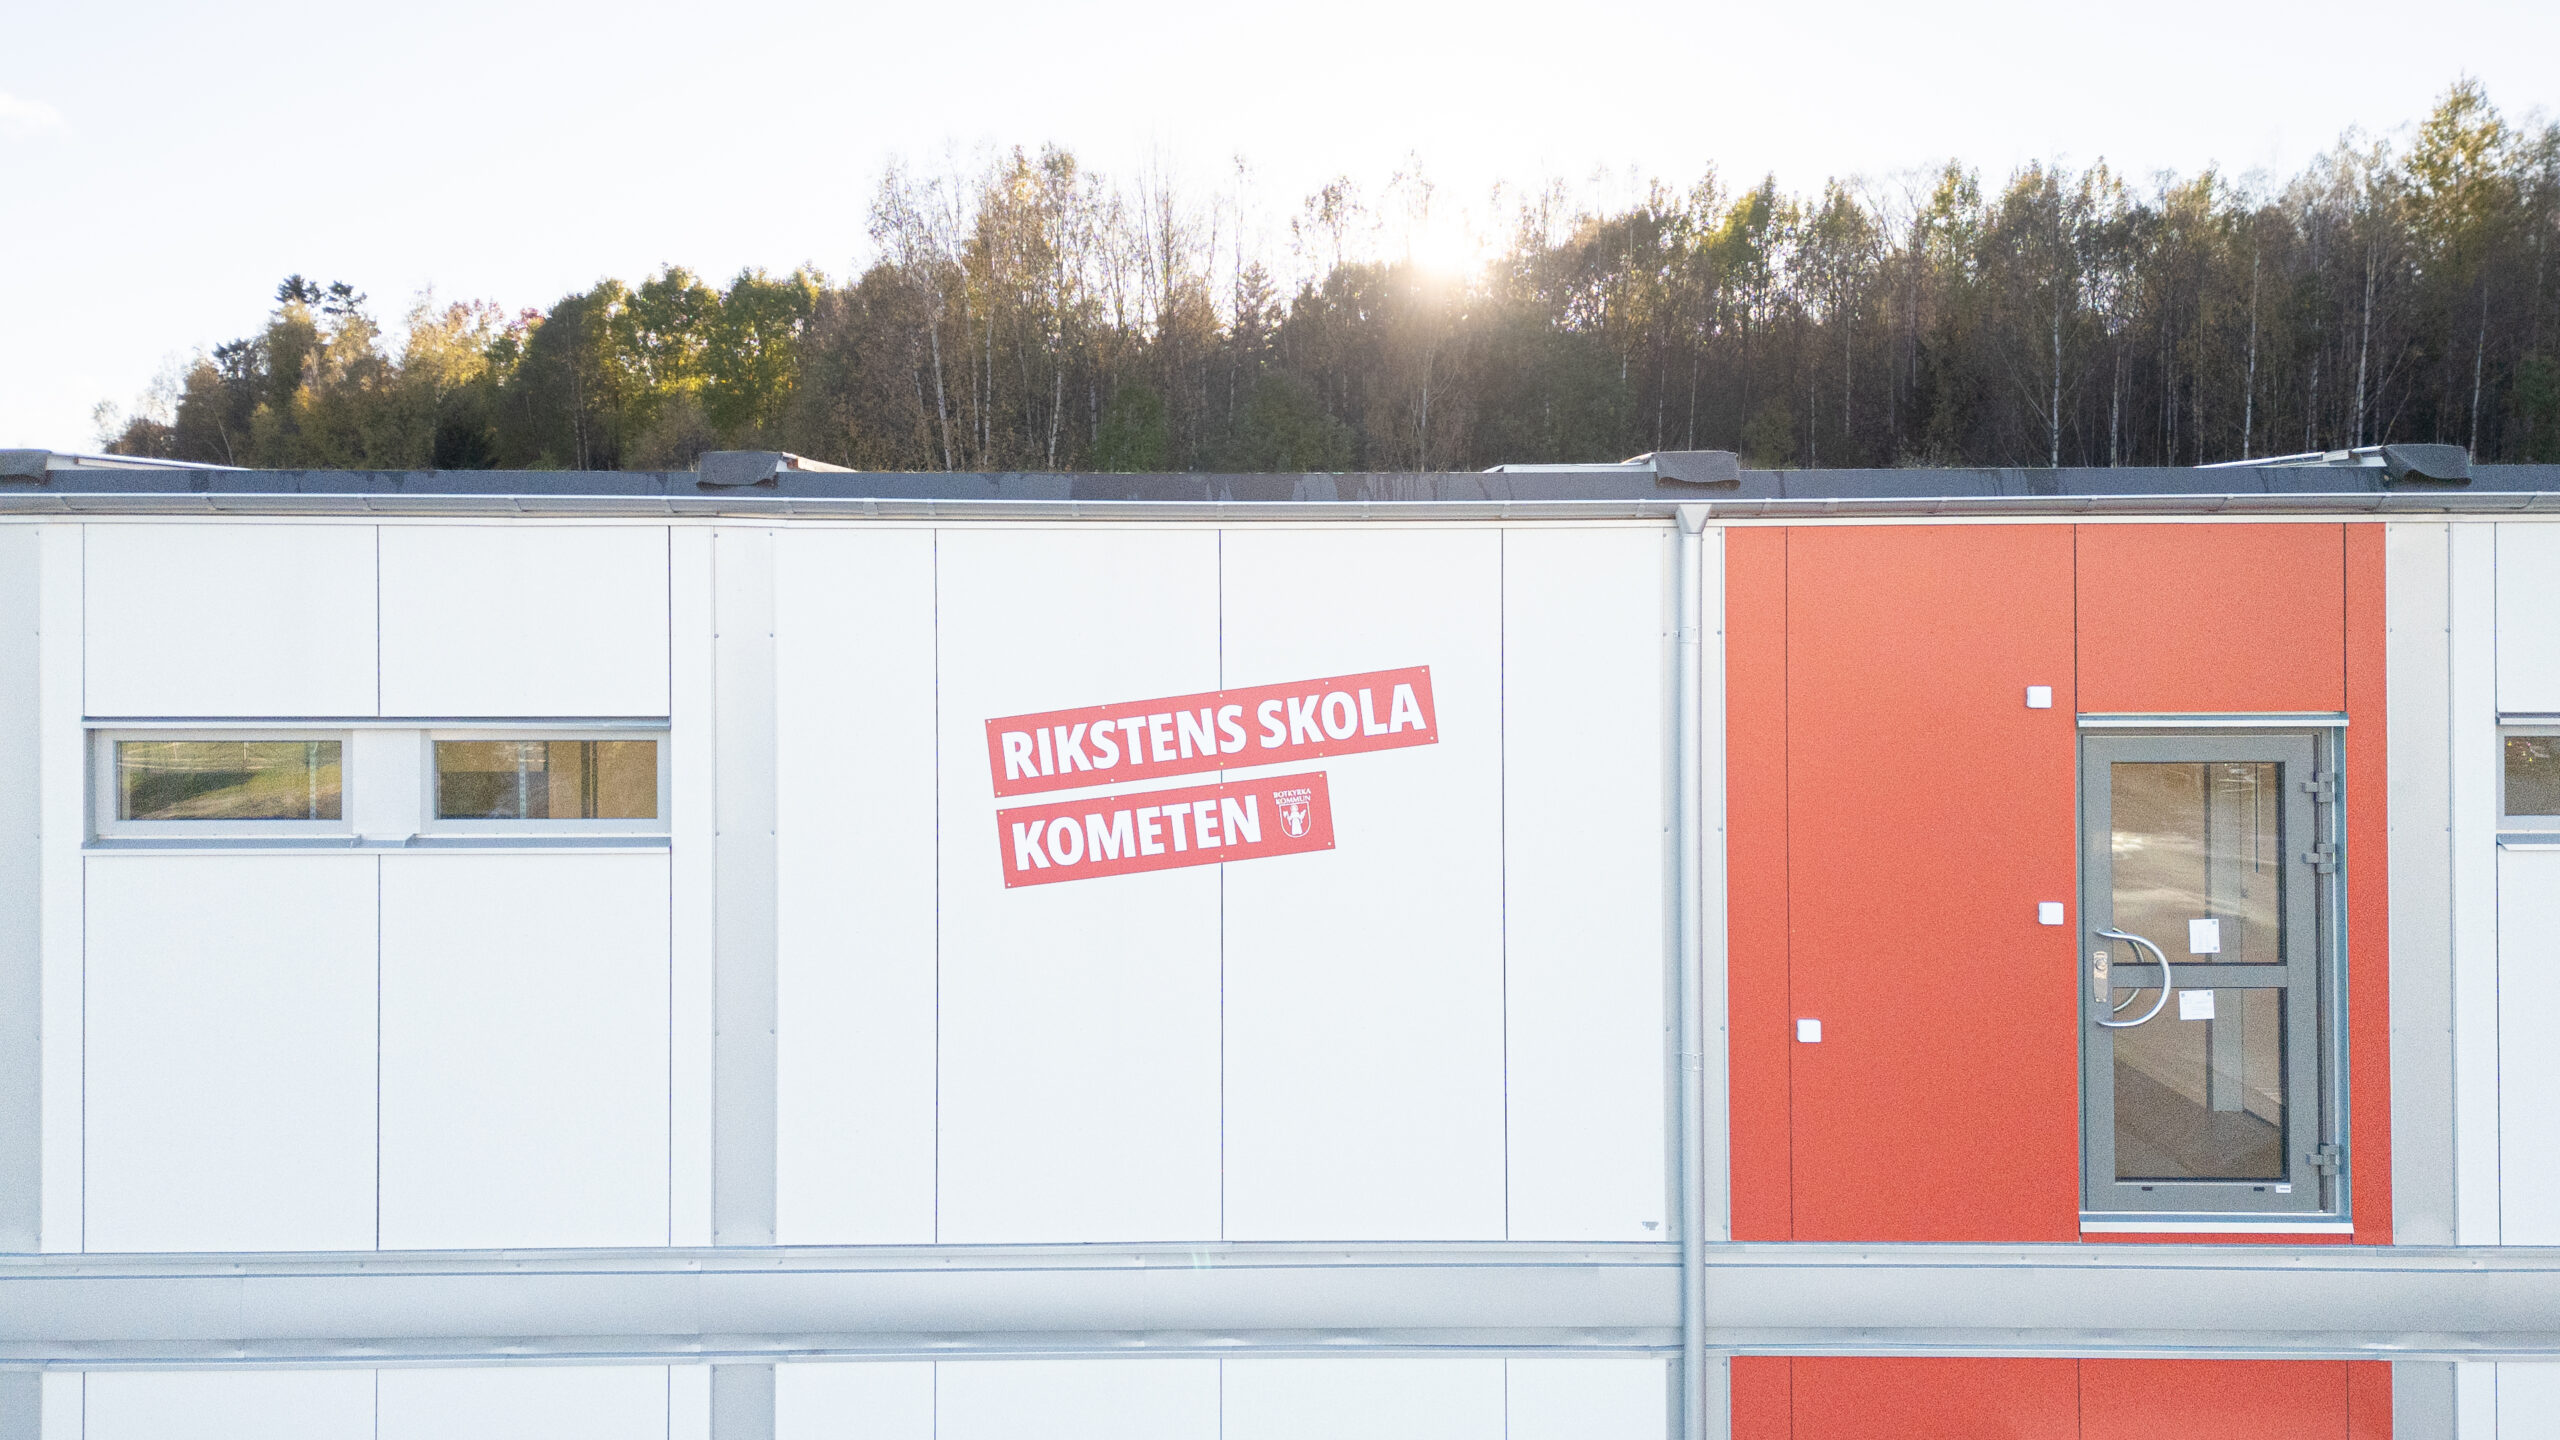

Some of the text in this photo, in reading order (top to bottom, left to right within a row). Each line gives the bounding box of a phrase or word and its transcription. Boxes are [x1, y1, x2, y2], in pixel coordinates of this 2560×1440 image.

[1001, 683, 1427, 781] RIKSTENS SKOLA
[1273, 788, 1311, 799] BOTKYRKA
[1275, 795, 1311, 805] KOMMUN
[1011, 794, 1262, 871] KOMETEN
